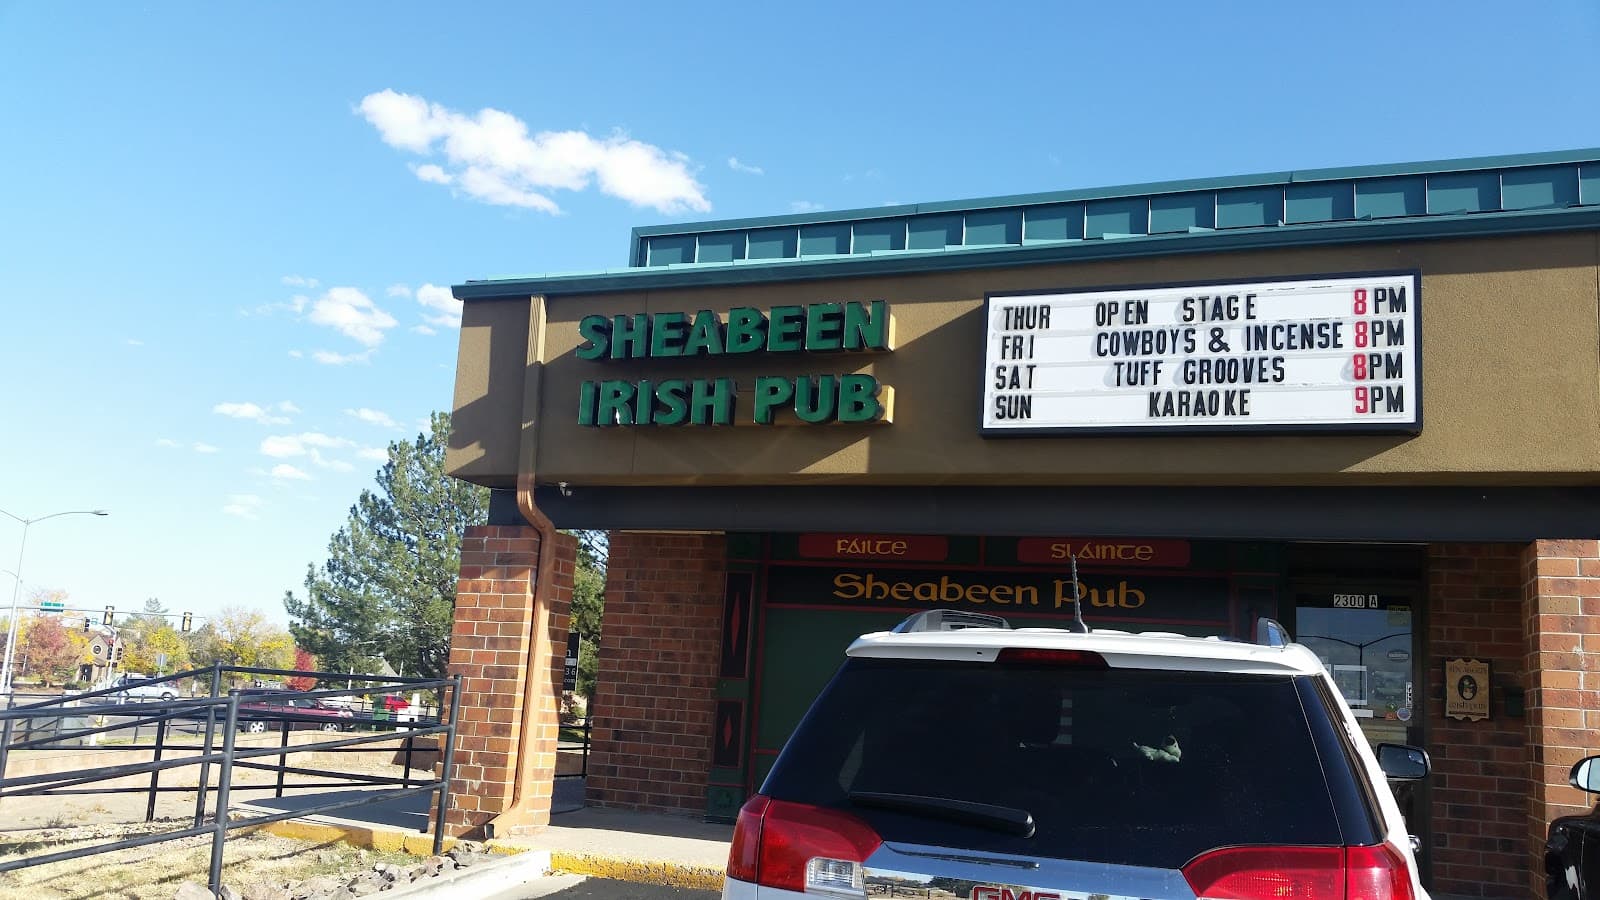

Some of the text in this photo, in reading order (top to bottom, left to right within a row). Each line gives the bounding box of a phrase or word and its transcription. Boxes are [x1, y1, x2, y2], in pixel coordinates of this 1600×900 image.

[576, 300, 889, 360] SHEABEEN
[1003, 305, 1051, 331] THUR
[1095, 300, 1149, 327] OPEN
[1182, 294, 1257, 322] STAGE
[1001, 319, 1405, 360] FRI COWBOYS & INCENSE 8PM
[995, 352, 1403, 390] SAT TUFF GROOVES 8PM
[577, 373, 884, 427] IRISH PUB
[995, 385, 1404, 420] SUN KARAOKE 9PM
[832, 572, 1146, 609] Sheabeen Pub
[1334, 595, 1377, 607] 2300 A
